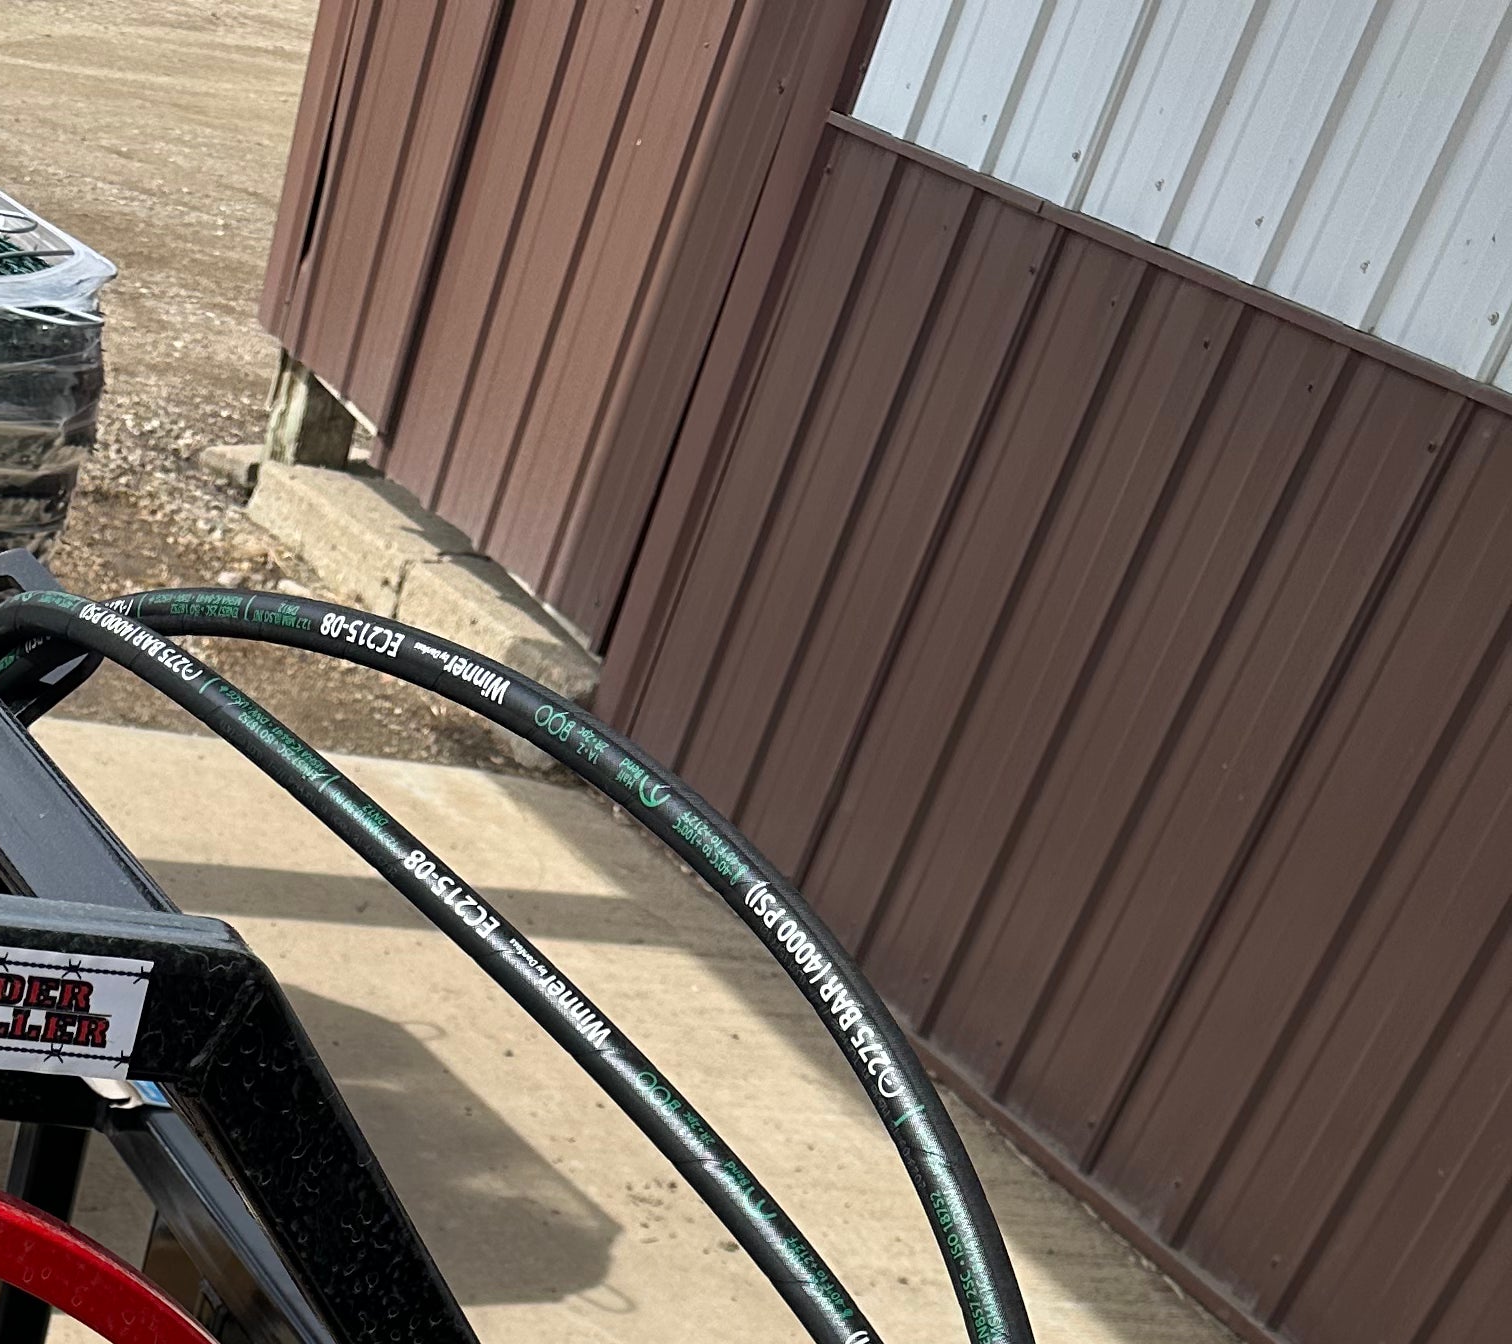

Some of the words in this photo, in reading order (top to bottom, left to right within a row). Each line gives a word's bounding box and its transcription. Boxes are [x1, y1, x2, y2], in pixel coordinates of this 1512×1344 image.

[132, 629, 164, 658] BAR
[157, 646, 188, 676] 275
[320, 612, 408, 659] EC215-08
[443, 656, 513, 706] Winner
[535, 704, 578, 742] 800
[402, 849, 502, 940] EC215-08
[744, 879, 788, 931] PSI)
[776, 919, 834, 985] (4000
[538, 975, 613, 1050] Winner
[819, 974, 864, 1033] BAR
[850, 1026, 896, 1077] 275
[928, 1189, 954, 1233] 18752
[945, 1232, 964, 1258] ISO
[958, 1270, 978, 1299] 2SC
